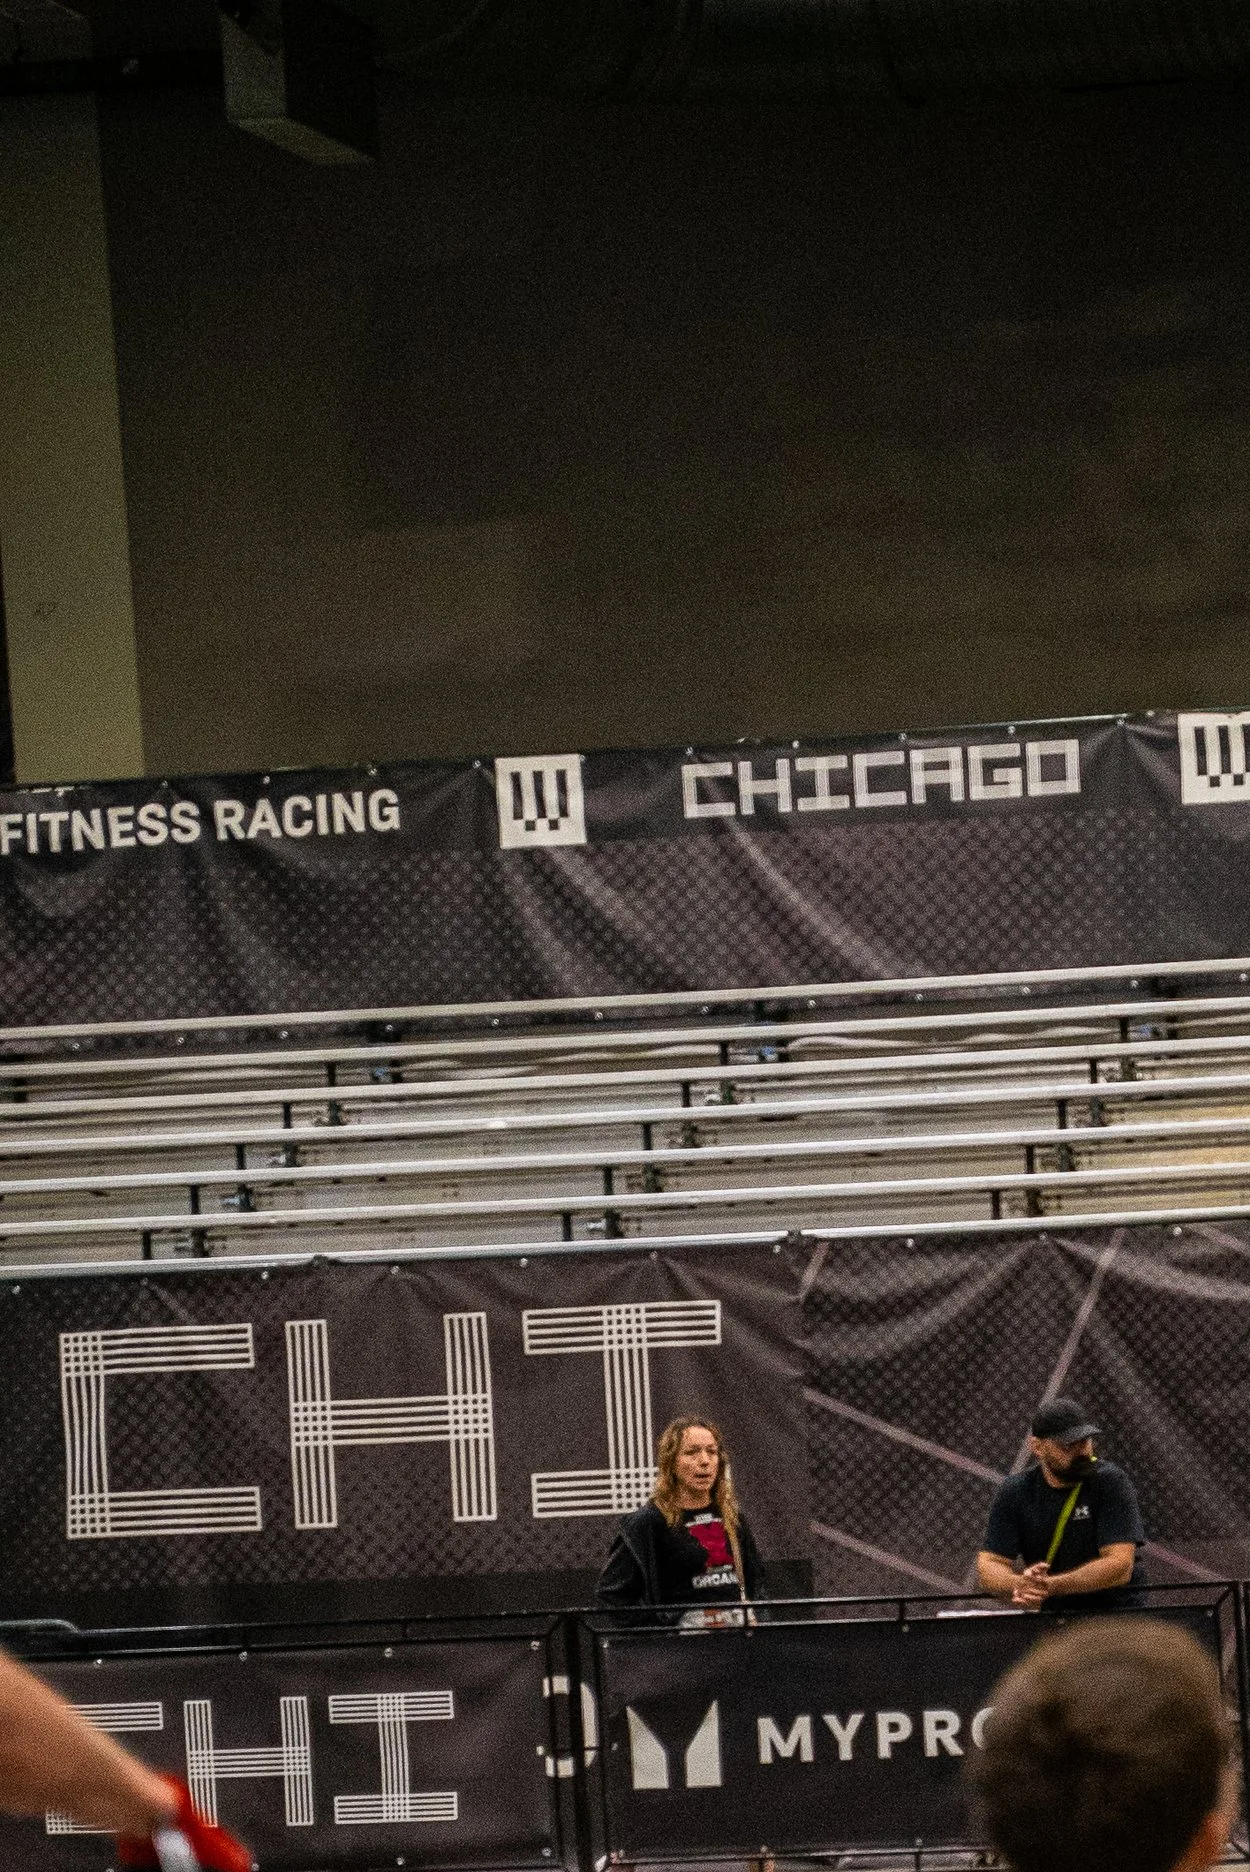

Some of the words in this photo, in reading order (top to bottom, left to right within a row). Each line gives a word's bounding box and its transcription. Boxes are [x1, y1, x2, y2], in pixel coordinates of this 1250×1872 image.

[682, 738, 1080, 818] CHICAGO
[0, 802, 201, 855] FITNESS
[214, 789, 400, 841] RACING
[60, 1300, 722, 1539] CHI
